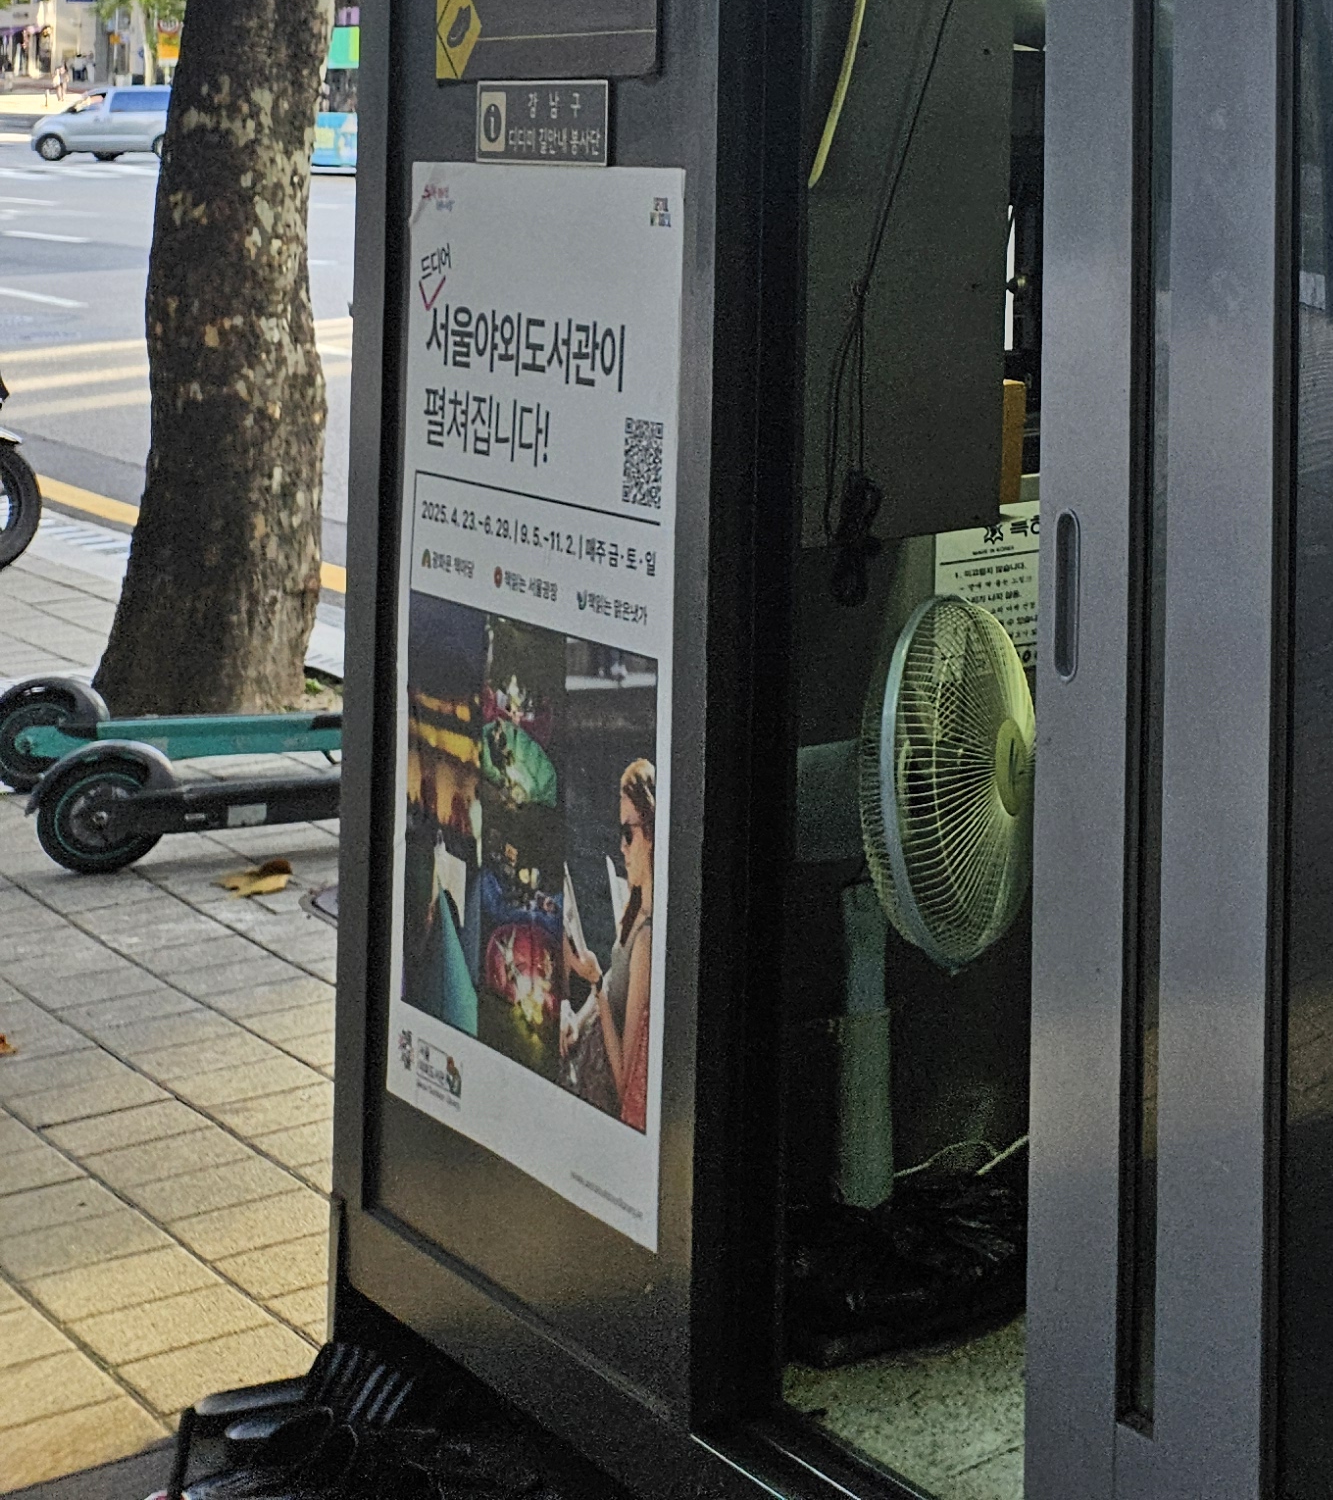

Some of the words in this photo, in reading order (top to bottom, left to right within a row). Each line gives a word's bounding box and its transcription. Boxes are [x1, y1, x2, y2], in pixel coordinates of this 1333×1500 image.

[420, 243, 452, 280] 드디어
[426, 303, 625, 393] 서울야외도서관이
[423, 386, 550, 468] 펼쳐집니다!
